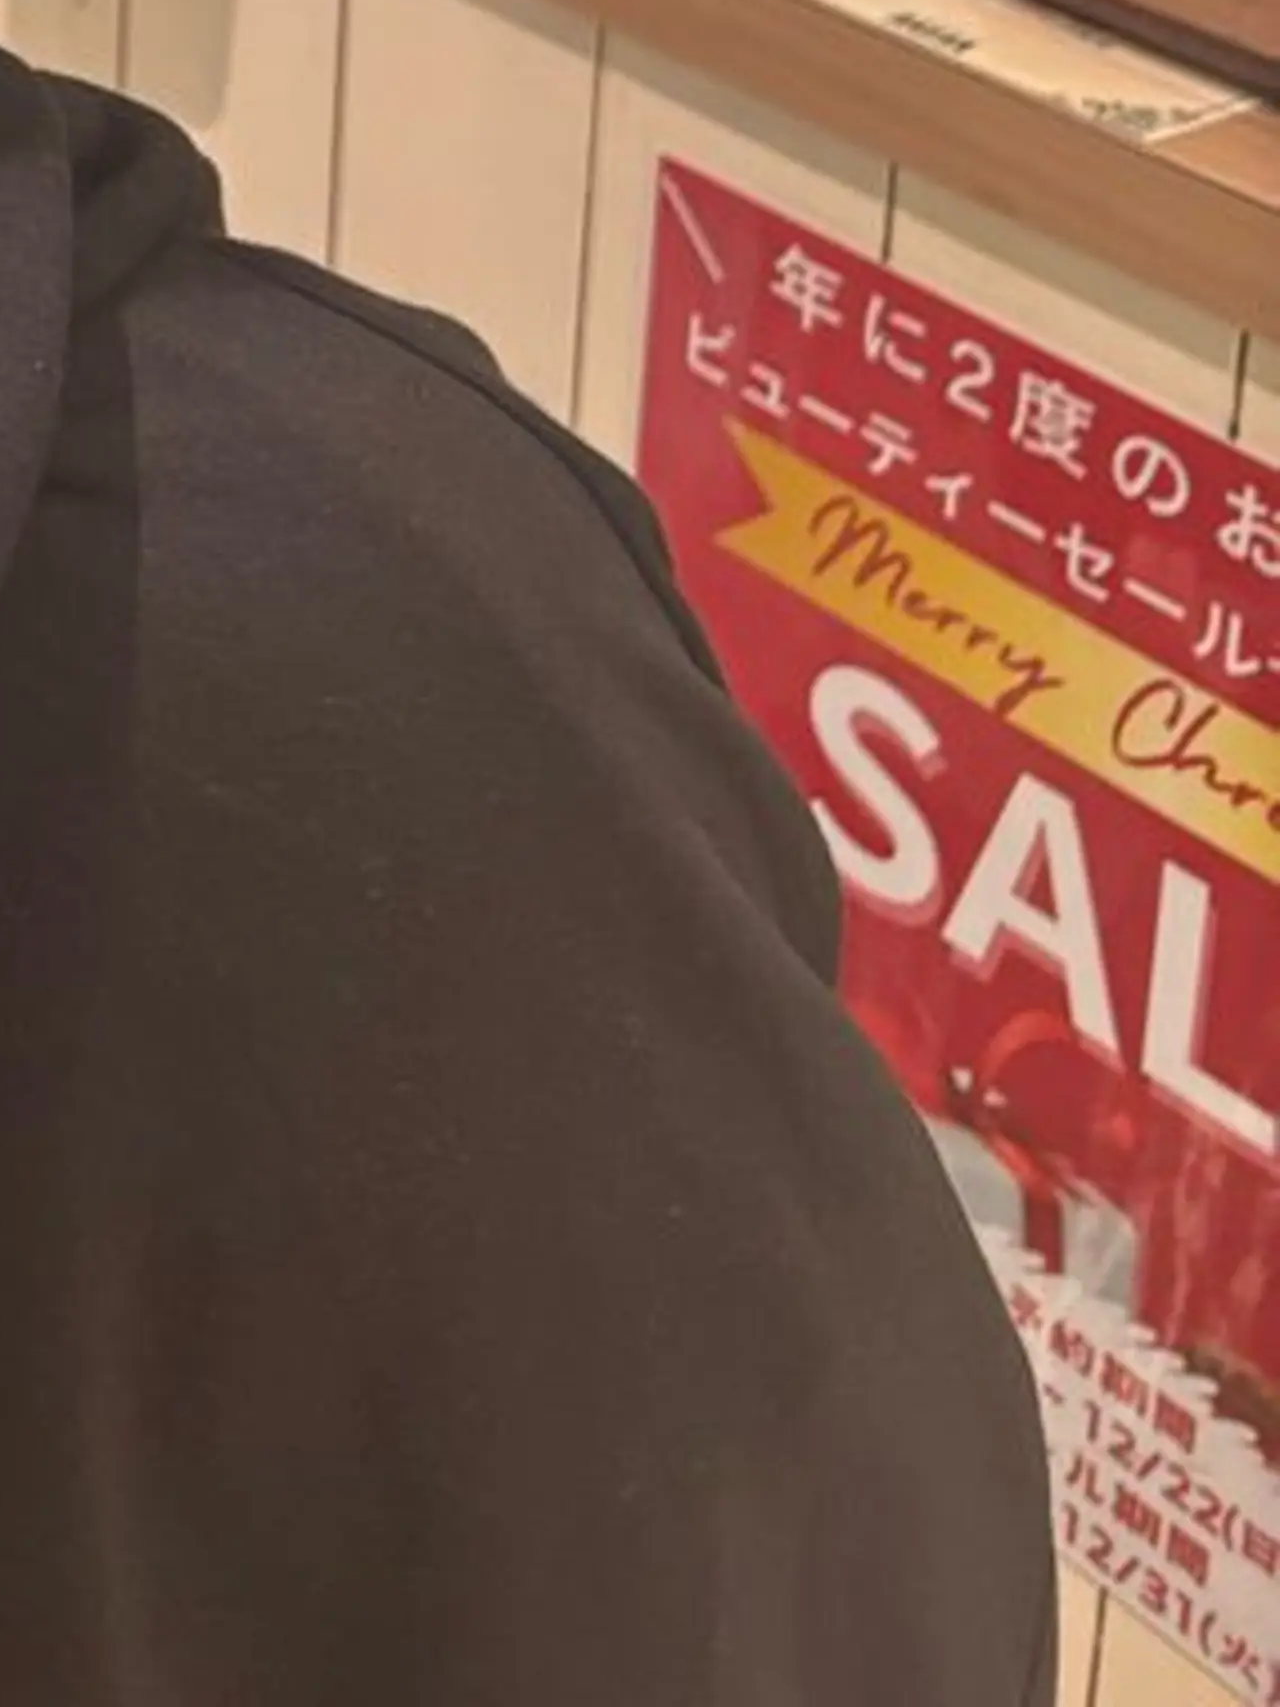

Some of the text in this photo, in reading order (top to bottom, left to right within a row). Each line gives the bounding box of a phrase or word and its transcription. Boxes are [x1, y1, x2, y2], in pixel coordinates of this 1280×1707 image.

[686, 314, 1280, 678] ビューティーセール
[806, 494, 1064, 717] Merry
[810, 664, 1276, 1159] SAL
